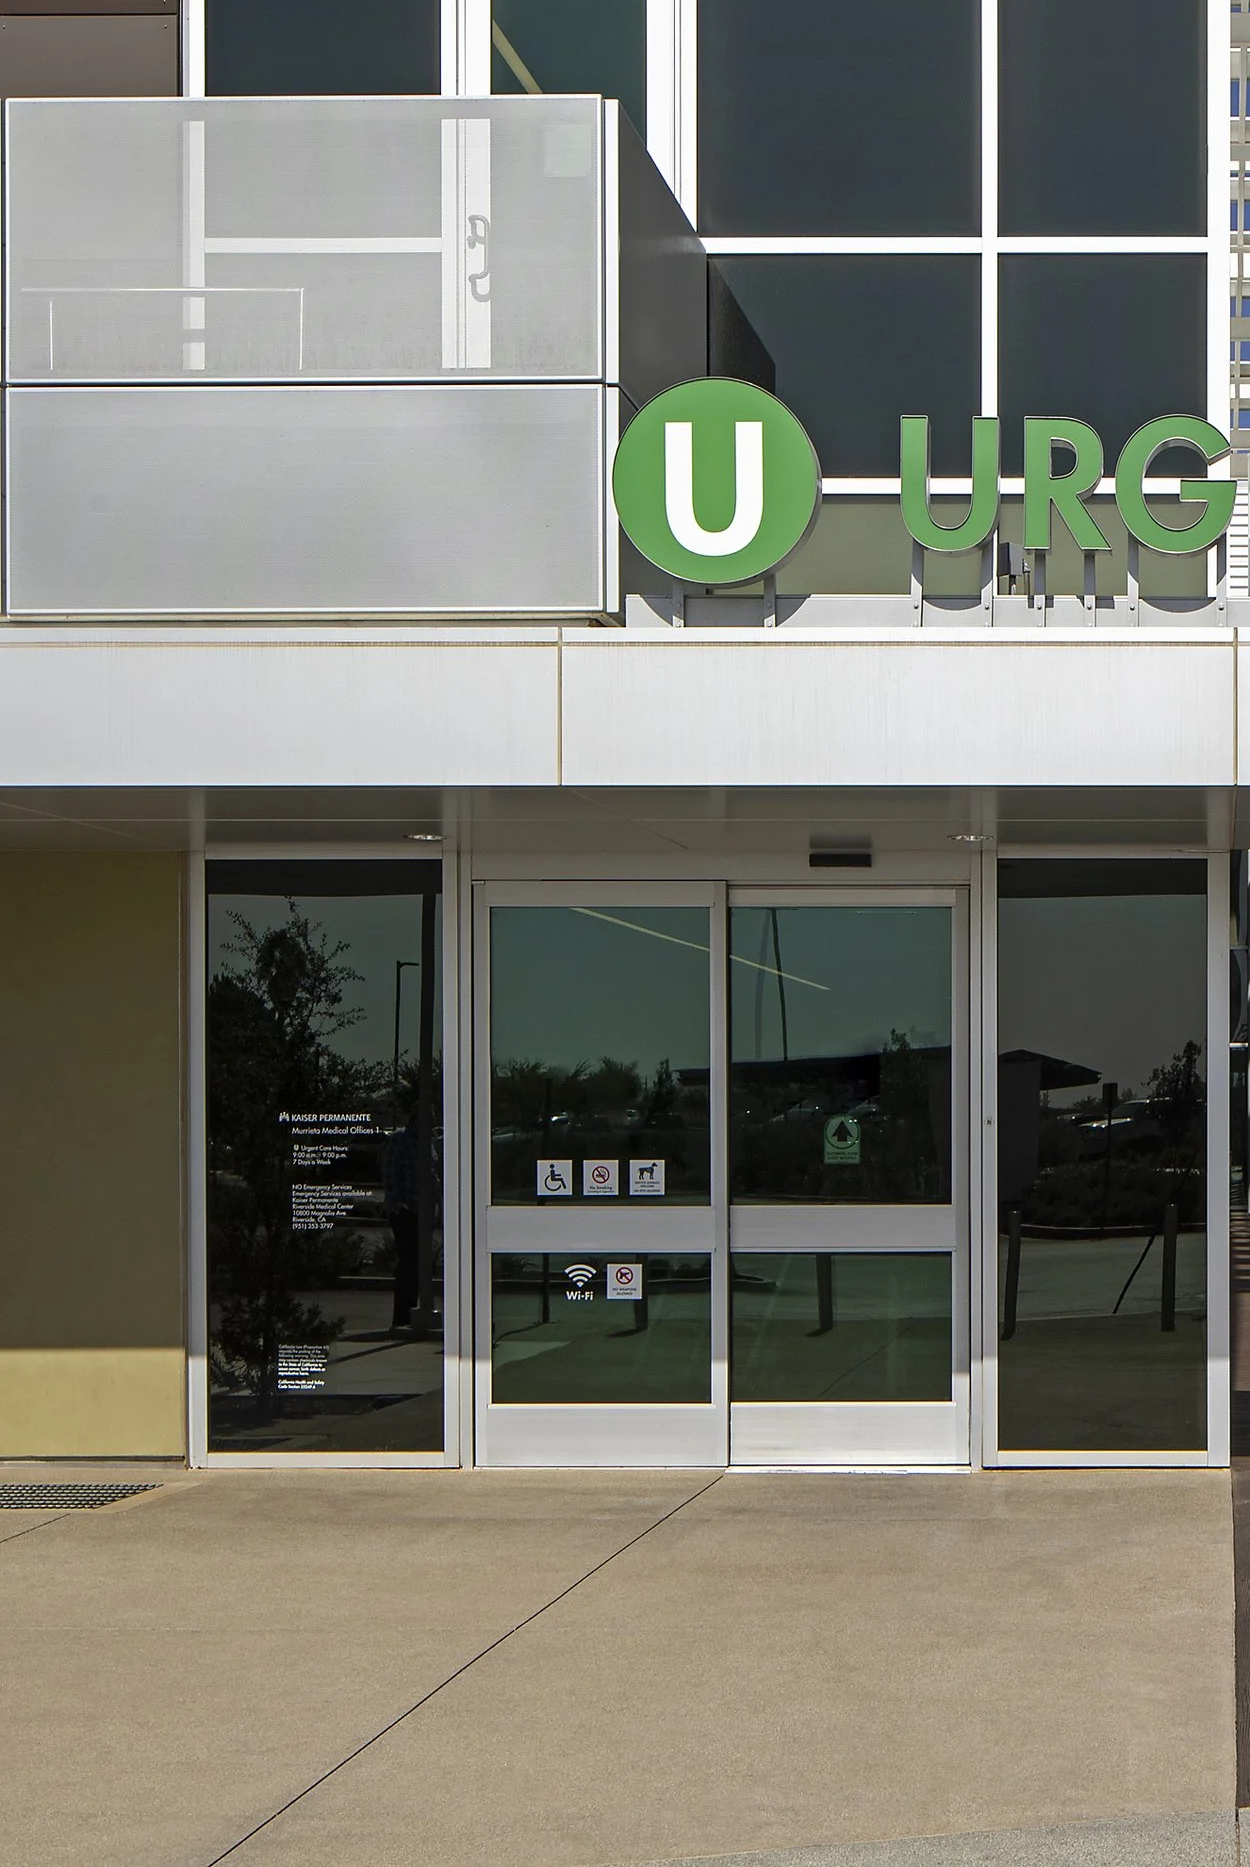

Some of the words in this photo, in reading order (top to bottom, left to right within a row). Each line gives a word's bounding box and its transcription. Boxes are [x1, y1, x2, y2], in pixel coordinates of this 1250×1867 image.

[664, 421, 764, 557] U
[291, 1113, 318, 1122] KAISER
[319, 1113, 371, 1122] PERMANENTE
[322, 1126, 348, 1134] Medical
[350, 1126, 373, 1134] Offices
